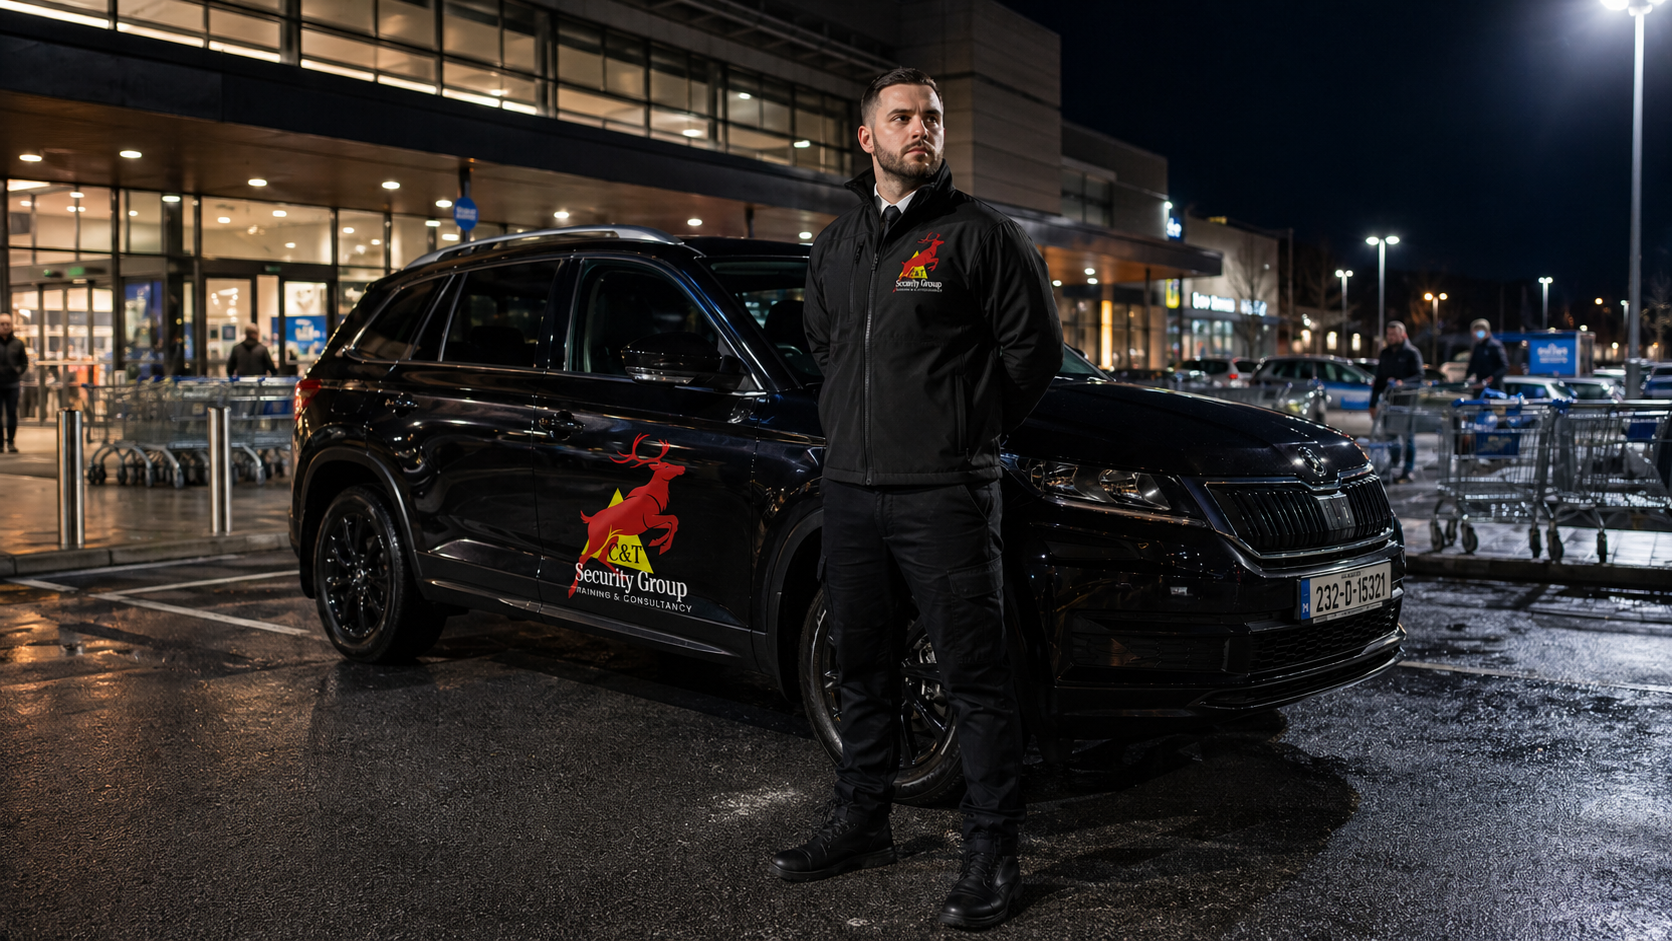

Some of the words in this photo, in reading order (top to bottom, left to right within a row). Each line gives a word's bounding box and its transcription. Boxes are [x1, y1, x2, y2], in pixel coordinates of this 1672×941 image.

[920, 279, 943, 290] Group
[608, 542, 643, 564] C&T
[575, 562, 634, 594] Security
[637, 571, 688, 603] Group
[1315, 572, 1386, 613] 232-D-15321
[613, 592, 620, 601] &
[623, 594, 693, 613] CONSULTANCY
